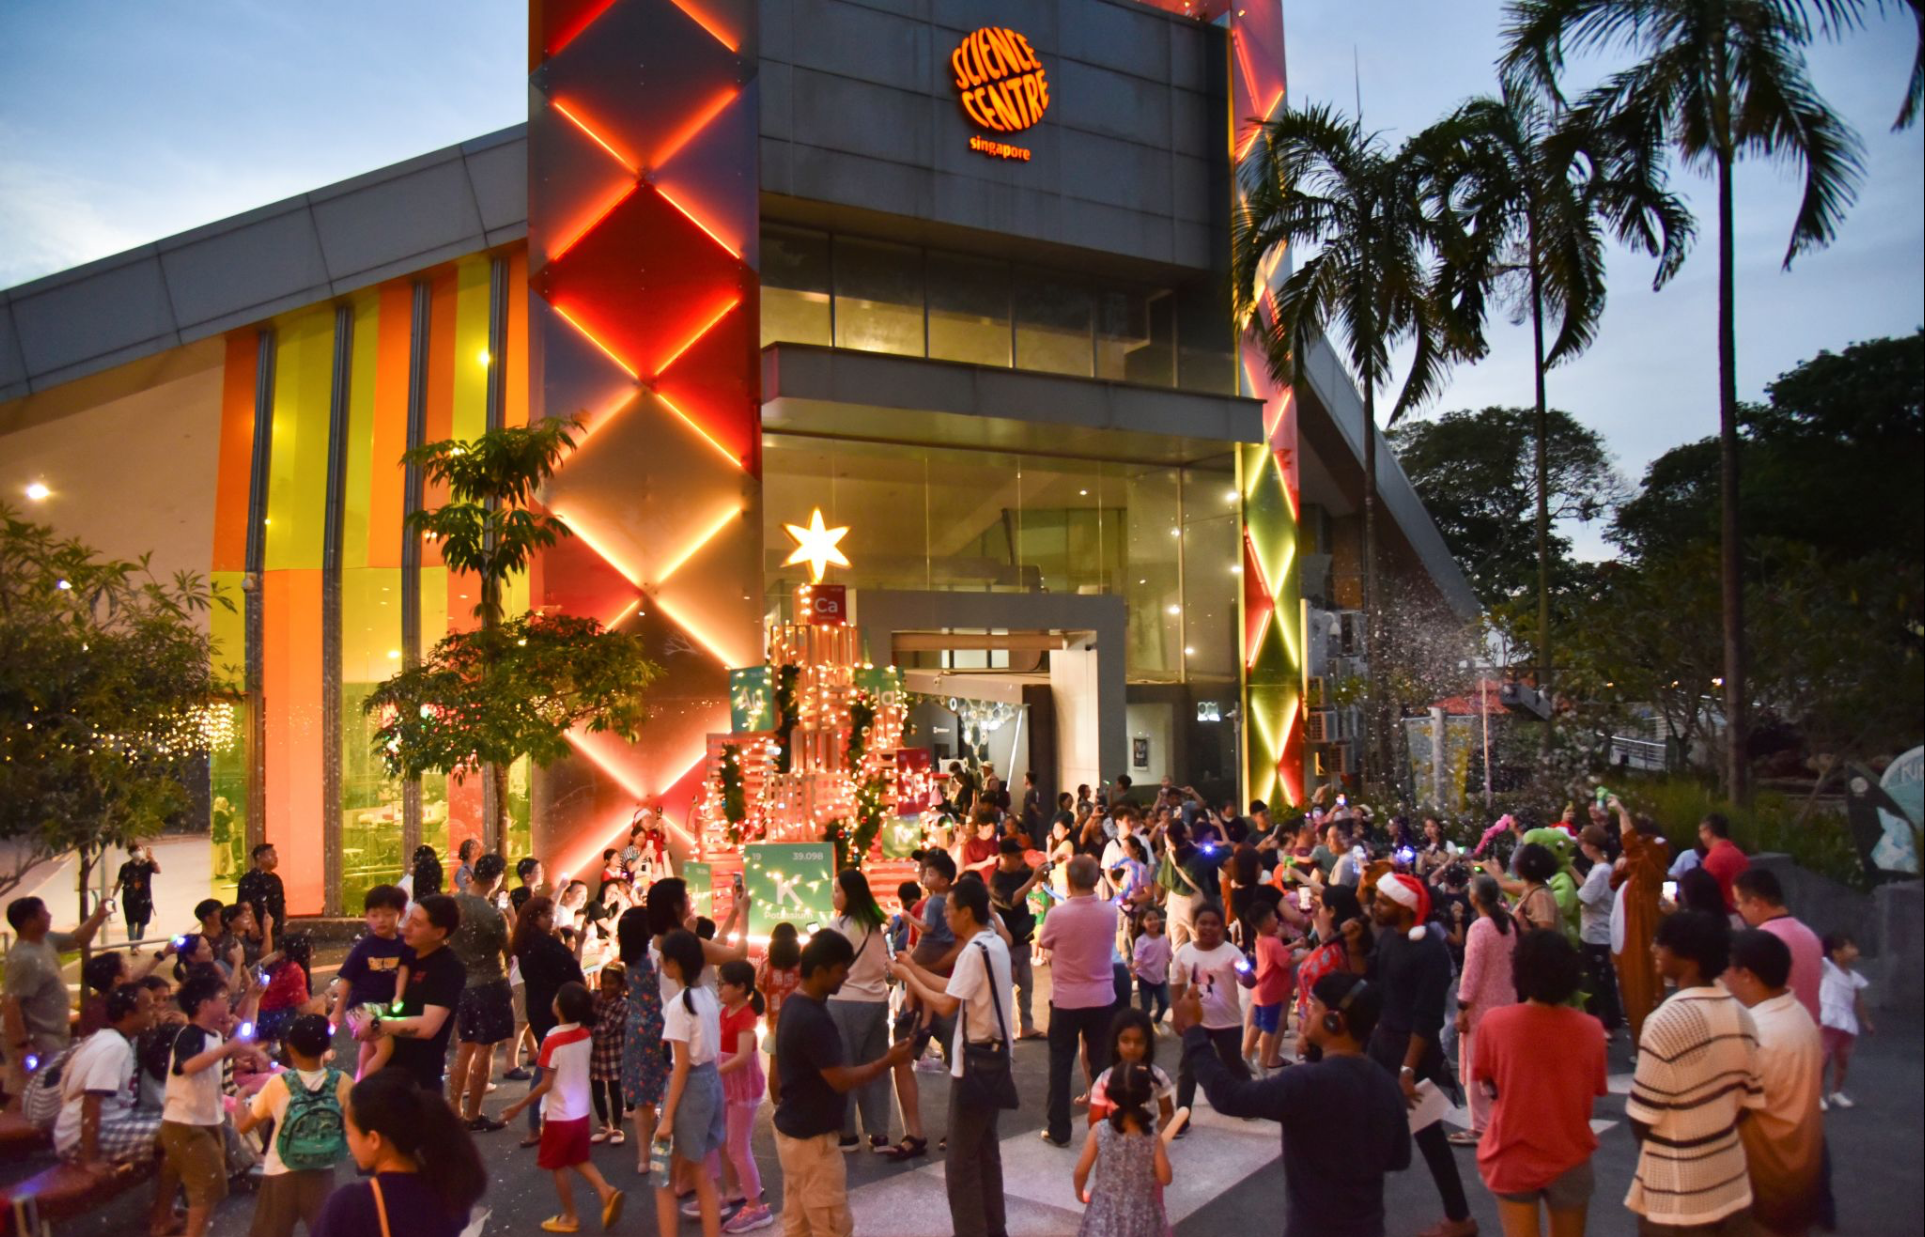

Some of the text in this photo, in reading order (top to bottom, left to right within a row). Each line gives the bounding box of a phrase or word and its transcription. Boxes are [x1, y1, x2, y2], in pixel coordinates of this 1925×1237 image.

[952, 26, 1042, 90] SCIENCE
[961, 68, 1049, 131] CENTRE
[969, 135, 1031, 161] singapore
[815, 597, 838, 613] Ca
[752, 851, 824, 861] 19 39.098
[776, 873, 804, 906] K
